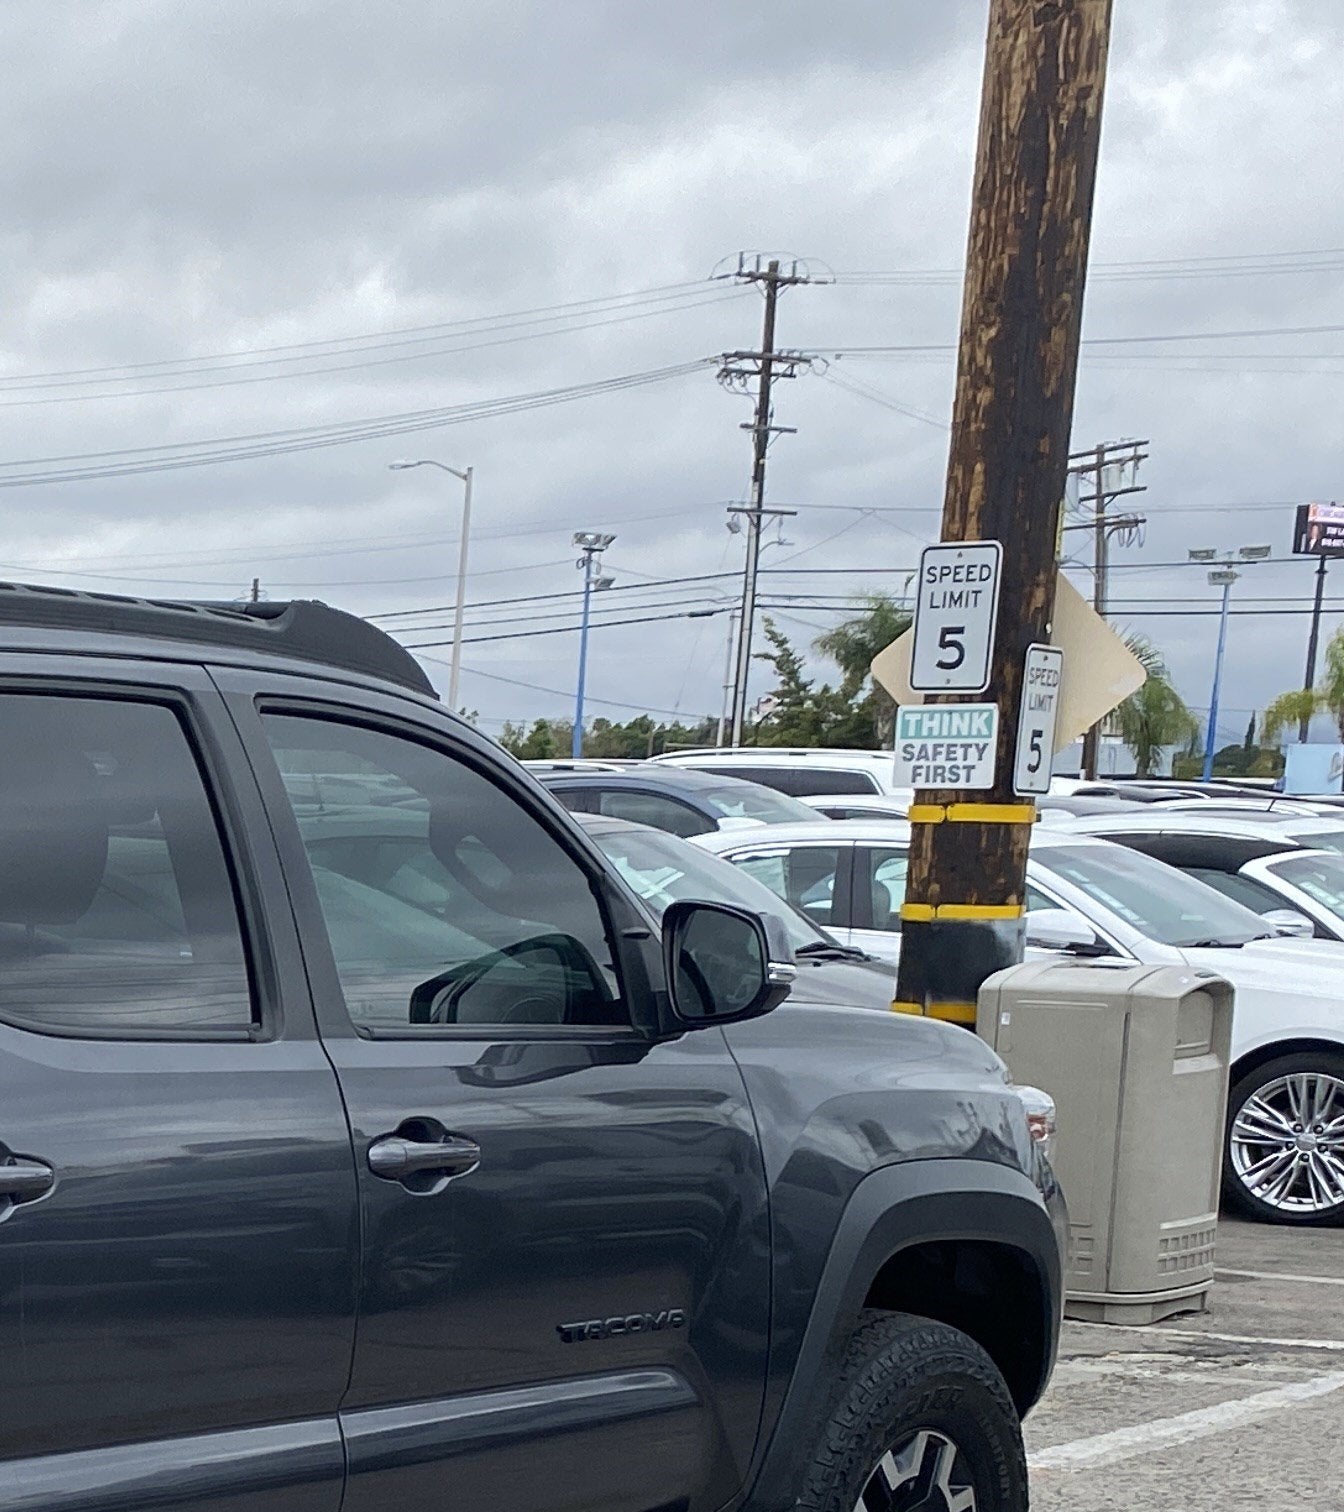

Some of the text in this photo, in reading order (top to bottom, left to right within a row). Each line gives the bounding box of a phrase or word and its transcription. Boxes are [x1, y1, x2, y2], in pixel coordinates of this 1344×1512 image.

[925, 564, 992, 583] SPEED
[929, 590, 982, 609] LIMIT
[935, 626, 966, 670] 5
[1028, 667, 1059, 687] SPEED
[1028, 693, 1053, 712] LIMIT
[904, 711, 991, 737] THINK
[902, 743, 989, 762] SAFETY
[1027, 729, 1044, 774] 5
[911, 764, 976, 784] FIRST
[556, 1306, 685, 1342] TACOMA
